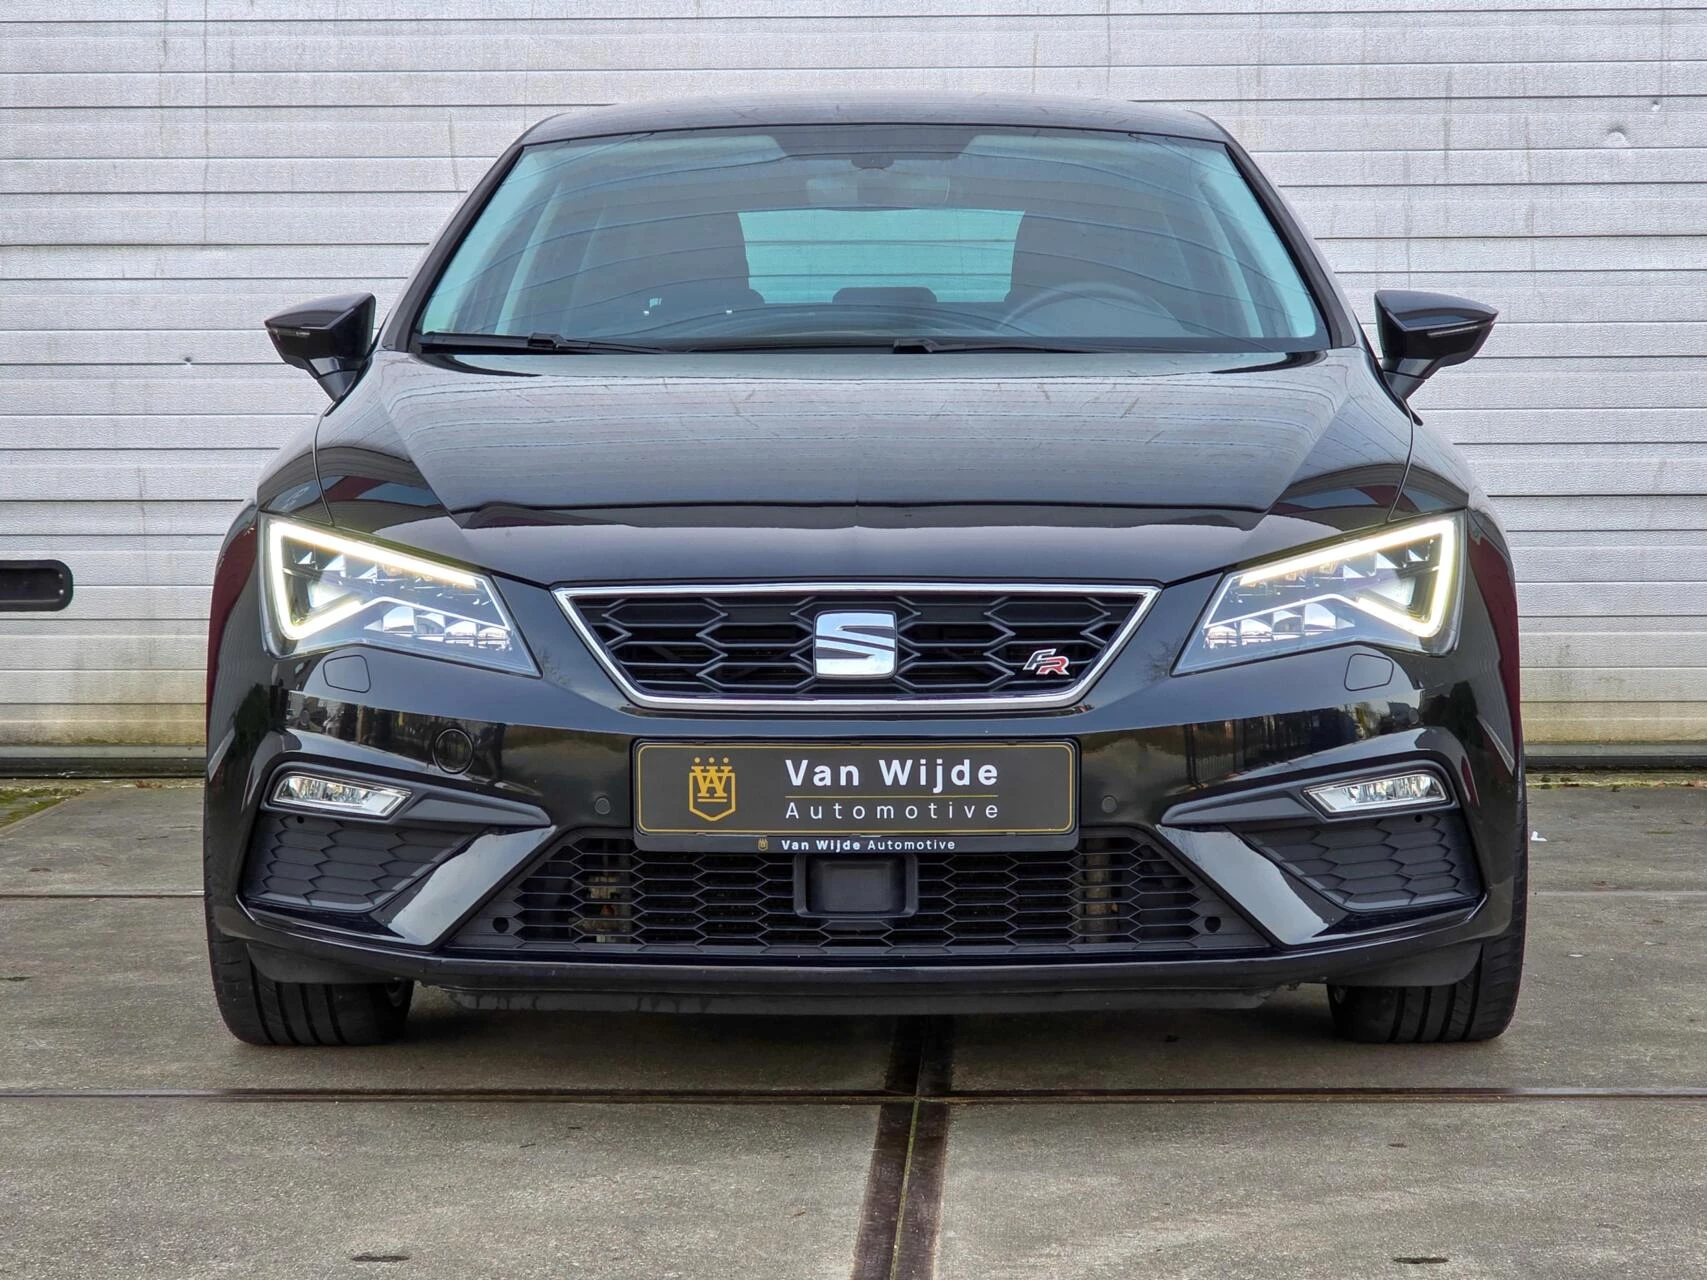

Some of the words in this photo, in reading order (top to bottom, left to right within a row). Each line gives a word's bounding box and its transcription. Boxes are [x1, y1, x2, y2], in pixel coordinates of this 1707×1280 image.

[1022, 648, 1070, 676] FR
[784, 758, 861, 786] Van
[878, 758, 999, 794] Wijde
[785, 801, 999, 820] Automotive
[781, 839, 810, 850] Van
[815, 839, 861, 853] Wijde
[867, 839, 956, 850] Automotive
